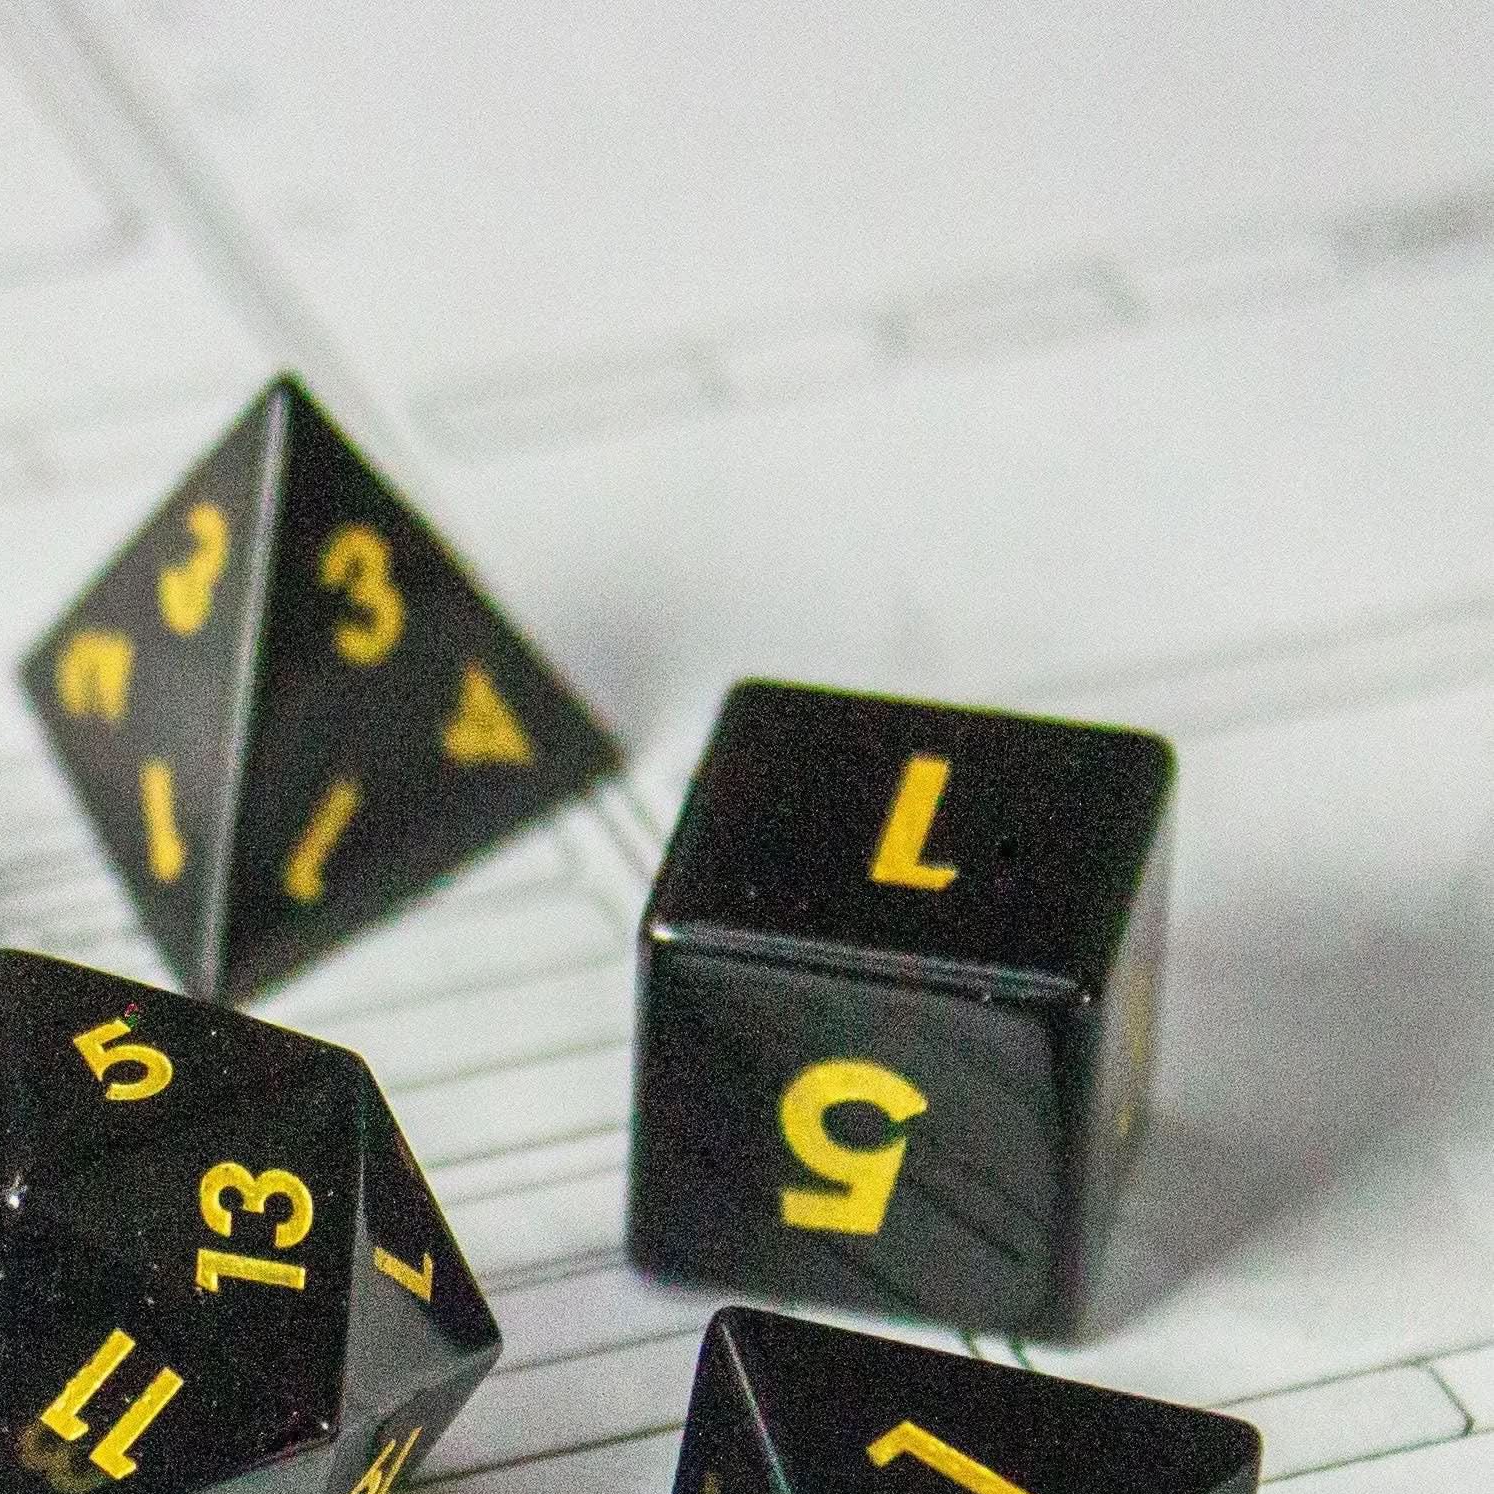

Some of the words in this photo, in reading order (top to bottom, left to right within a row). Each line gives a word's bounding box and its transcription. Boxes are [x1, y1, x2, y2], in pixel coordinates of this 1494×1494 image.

[321, 524, 405, 665] 3
[869, 754, 957, 891] 1
[73, 1018, 174, 1102] 5
[779, 1058, 929, 1237] 5
[195, 1160, 314, 1293] 13
[38, 1329, 185, 1481] 11
